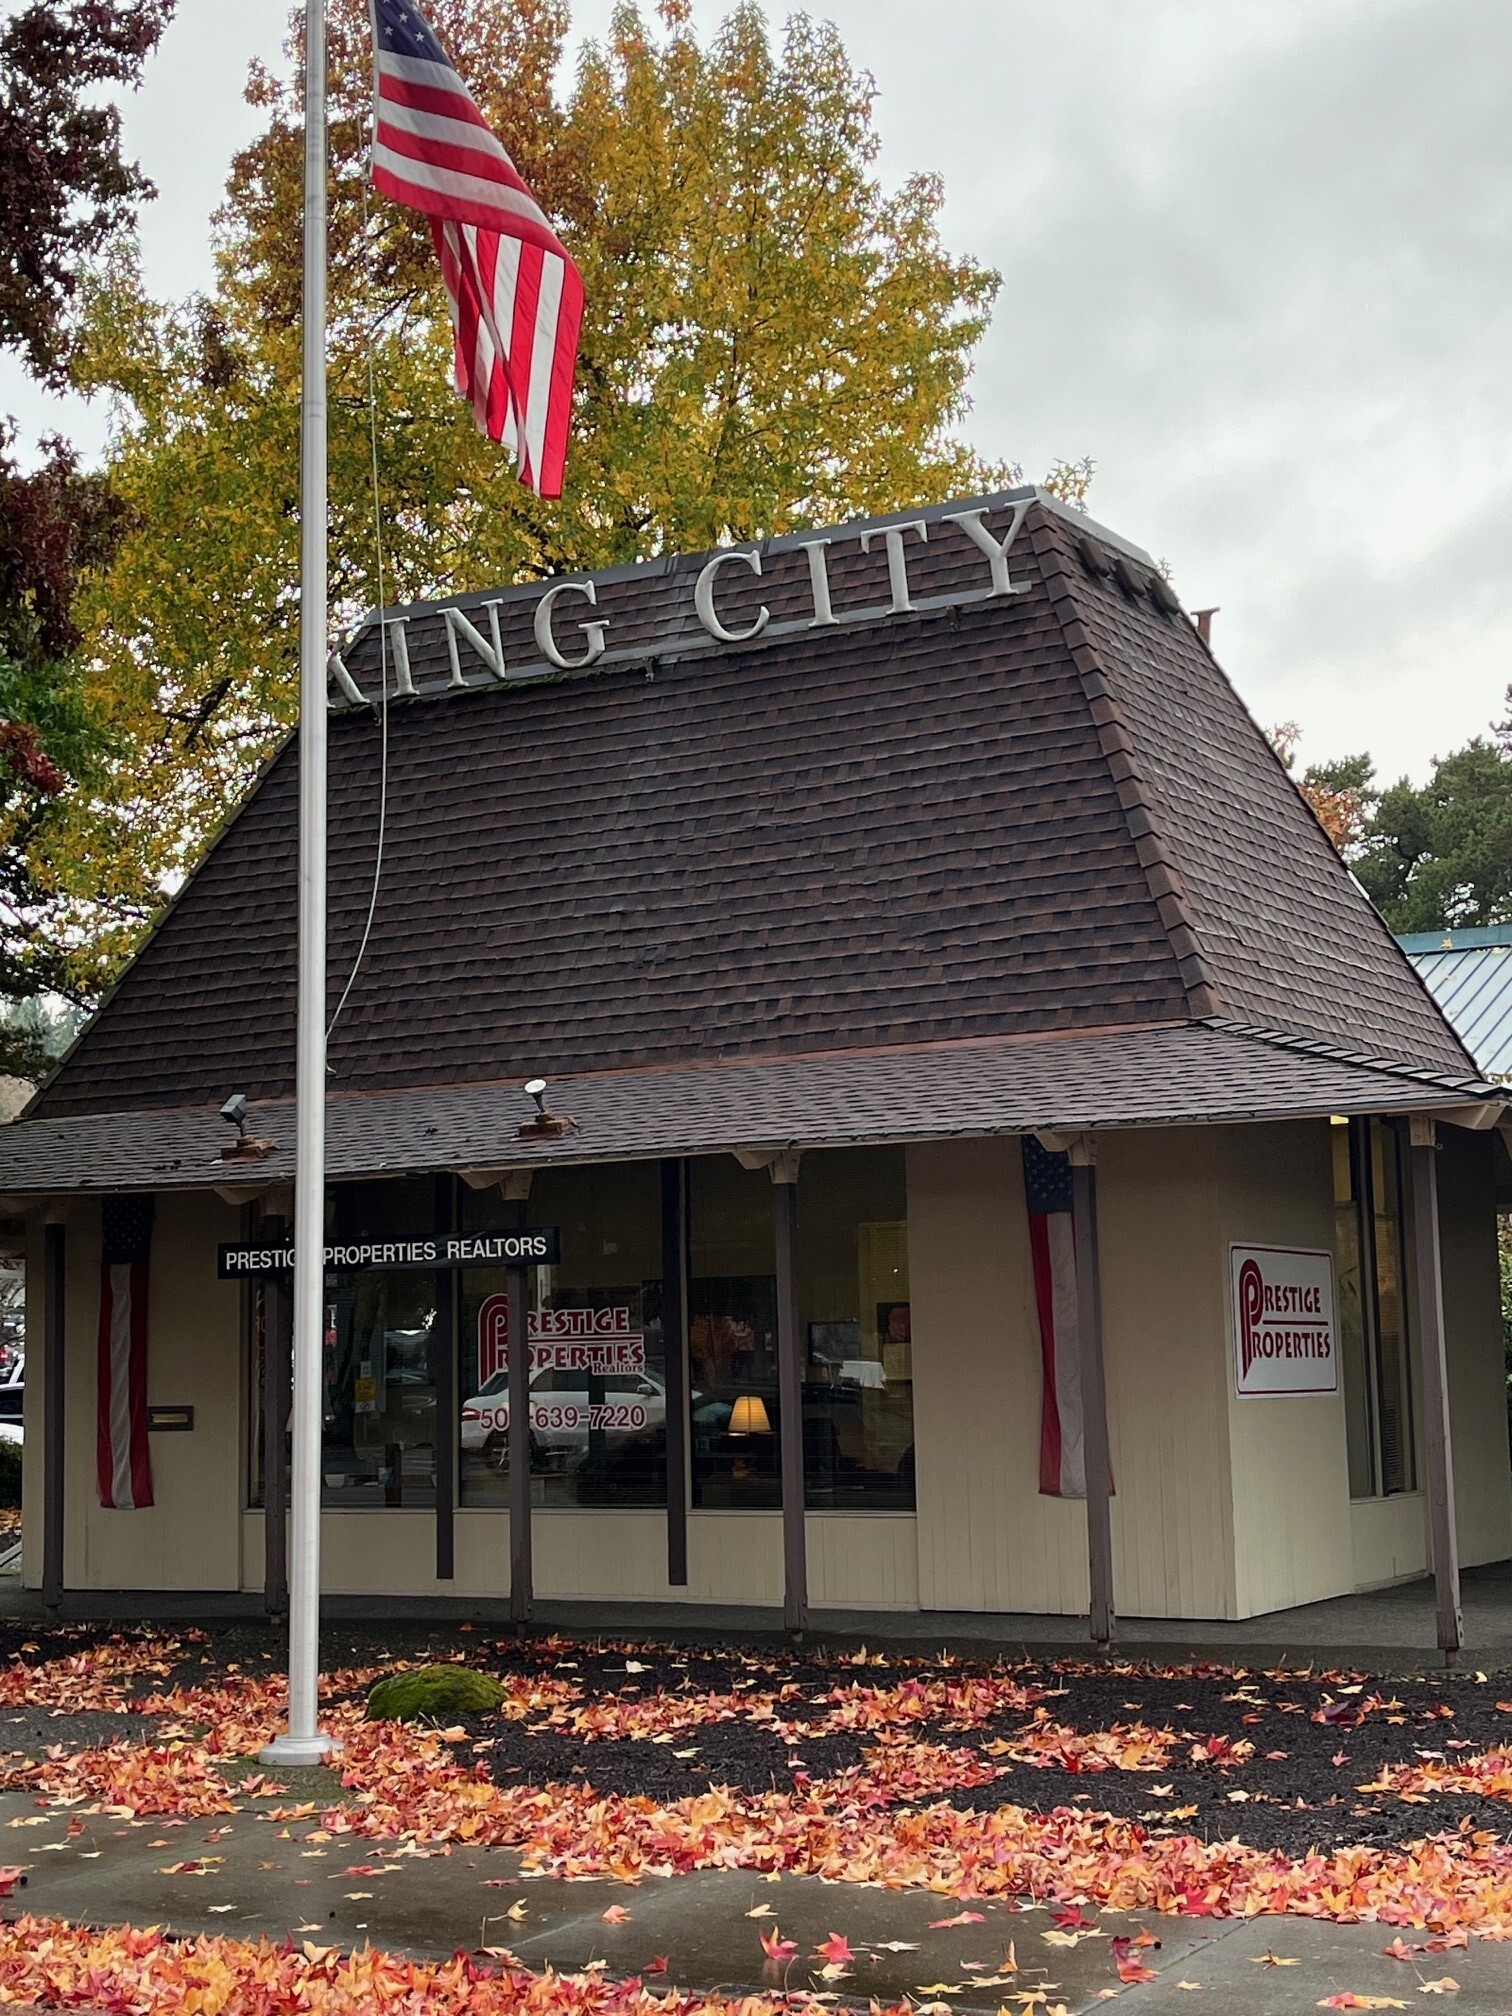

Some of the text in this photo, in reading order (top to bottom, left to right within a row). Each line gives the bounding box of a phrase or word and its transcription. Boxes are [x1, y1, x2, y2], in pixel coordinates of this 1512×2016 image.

[694, 497, 1039, 643] CITY
[226, 1237, 547, 1270] PRESTIG PROPERTIES REALTORS
[1239, 1258, 1321, 1326] PRESTIGE
[593, 1362, 644, 1374] Realtors
[480, 1404, 645, 1431] 50-639-7220
